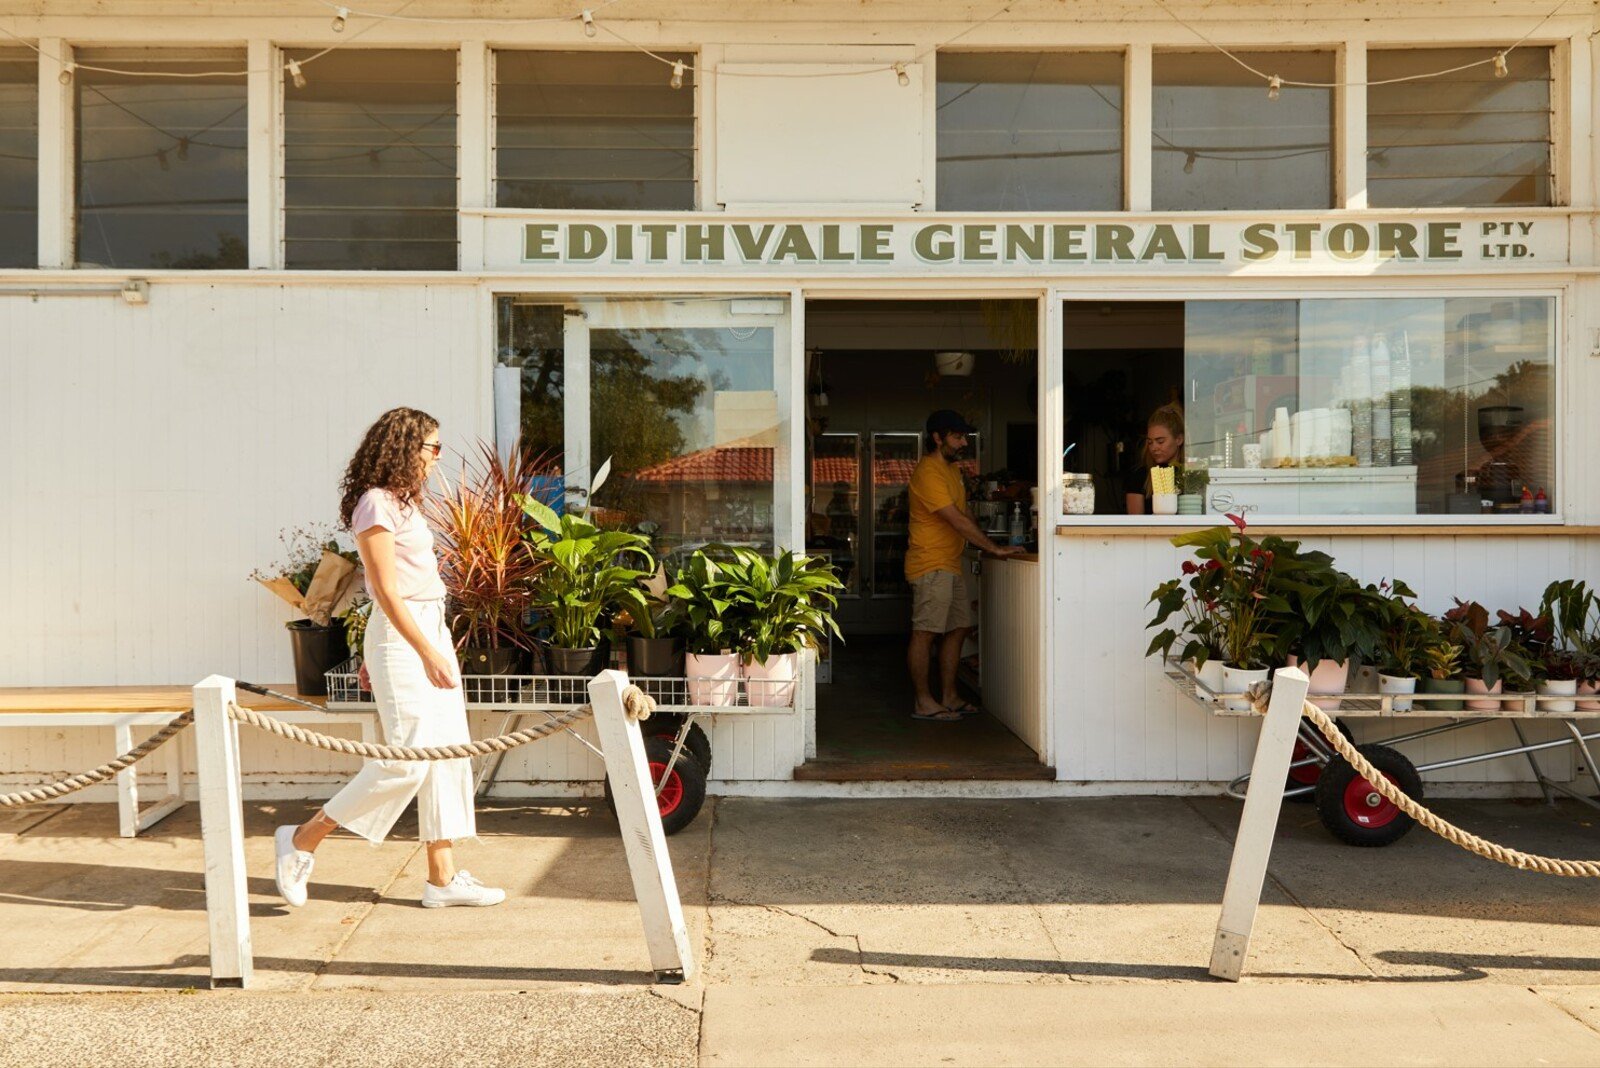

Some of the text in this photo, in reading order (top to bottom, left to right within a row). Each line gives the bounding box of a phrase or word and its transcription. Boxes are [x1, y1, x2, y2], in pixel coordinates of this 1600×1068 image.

[1481, 222, 1534, 236] PTY
[521, 222, 1463, 264] EDITHVALE GENERAL STORE
[1482, 244, 1535, 258] LTD.
